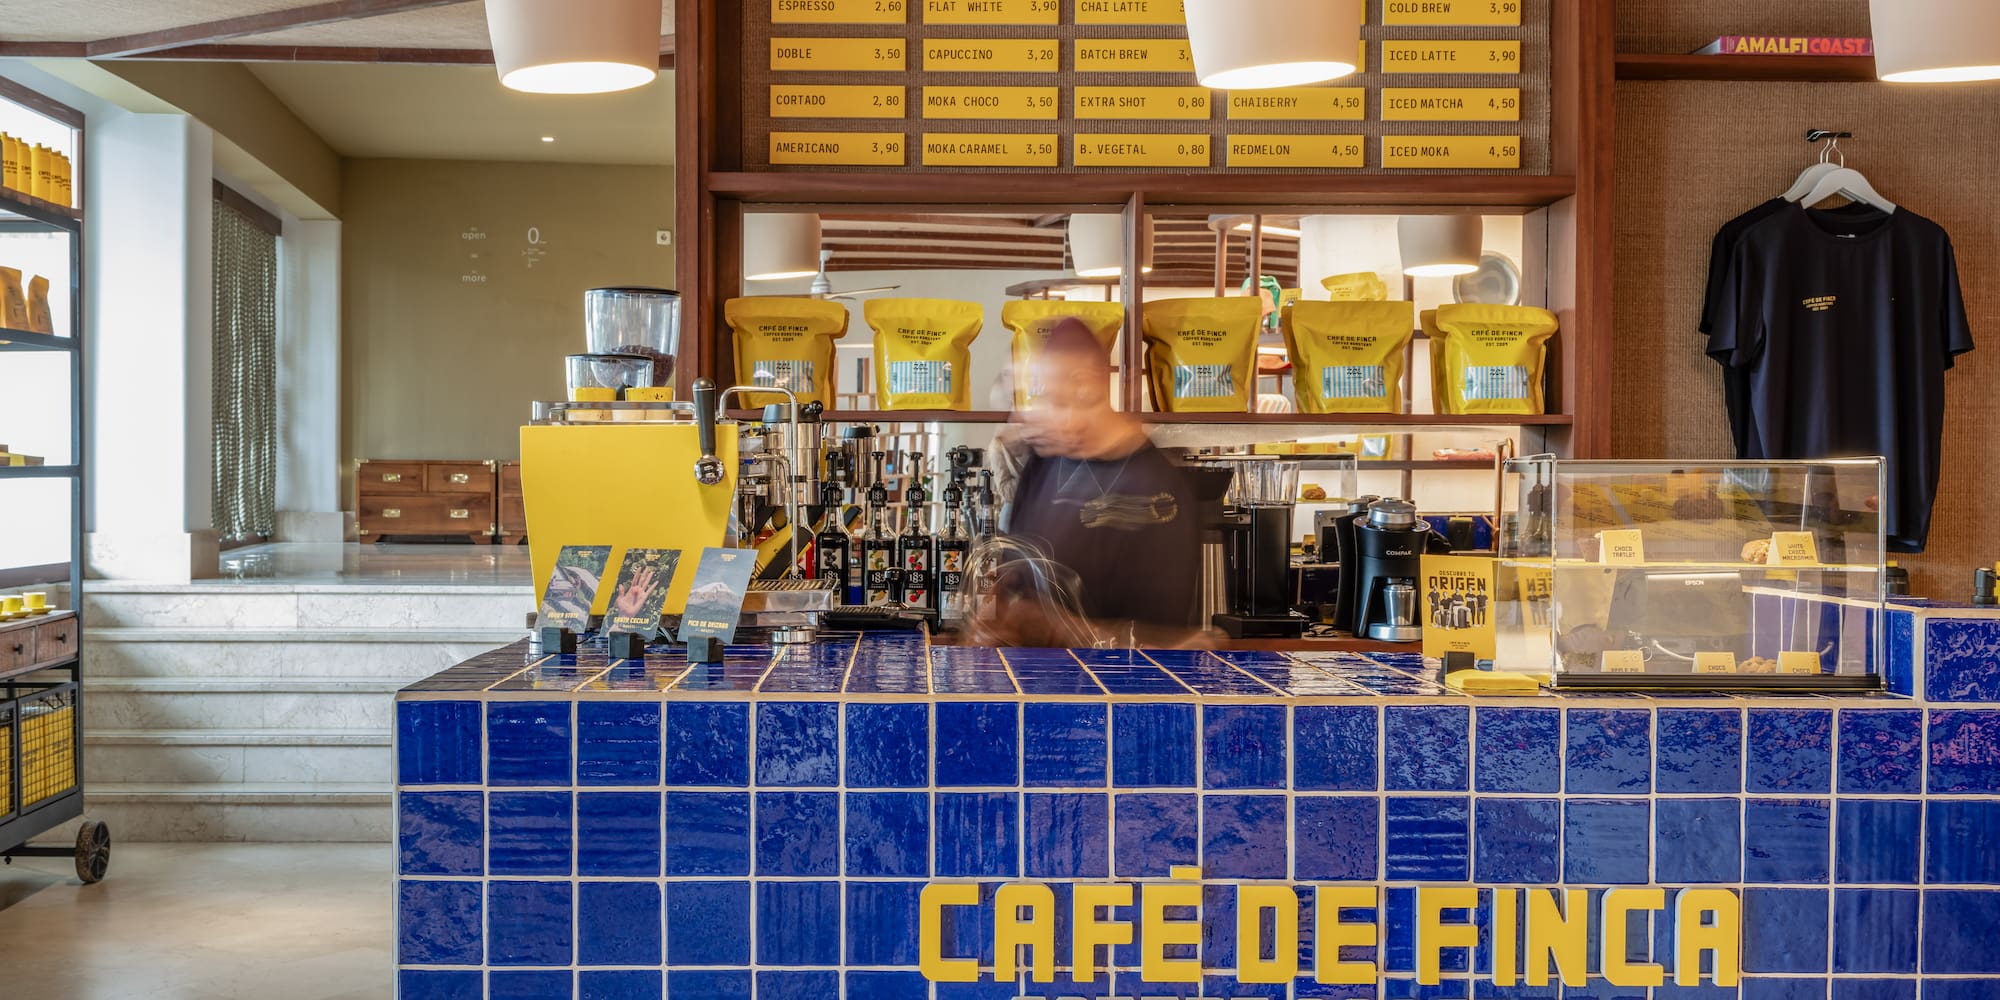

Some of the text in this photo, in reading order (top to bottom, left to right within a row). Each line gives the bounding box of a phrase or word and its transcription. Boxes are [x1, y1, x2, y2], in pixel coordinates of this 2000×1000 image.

[778, 0, 902, 13] ESPRESSO 2,60
[929, 1, 1058, 13] FLAT WHITE 3,90
[1081, 2, 1148, 12] CHAI LATTE
[1390, 3, 1517, 14] COLD BREW 3,90
[1735, 38, 1808, 54] AMALFI
[1810, 38, 1865, 54] COAST
[777, 48, 901, 61] DOBLE 3,50
[929, 49, 1054, 61] CAPUCCINO 3,20
[1081, 49, 1116, 60] BATCH
[1120, 50, 1148, 60] BREW
[1390, 51, 1516, 62] ICED LATTE 3,90
[776, 95, 899, 107] CORTADO 2,80
[928, 96, 1053, 108] MOKA CHOCO 3,50
[1081, 97, 1205, 109] EXTRA SHOT 0,80
[1234, 97, 1360, 109] CHAIBERRY 4,50
[1390, 98, 1516, 110] ICED MATCHA 4,50
[776, 142, 899, 155] AMERICANO 3,90
[928, 144, 1053, 155] MOKA CARAMEL 3,50
[1081, 144, 1205, 156] B. VEGETAL 0,80
[1234, 145, 1359, 157] REDMELON 4,50
[1390, 146, 1516, 158] ICED MOKA 4,50
[462, 232, 486, 240] open
[462, 274, 487, 282] more
[1429, 576, 1486, 591] ORIGEN
[920, 865, 1739, 987] CAFÉ DE FINCA
